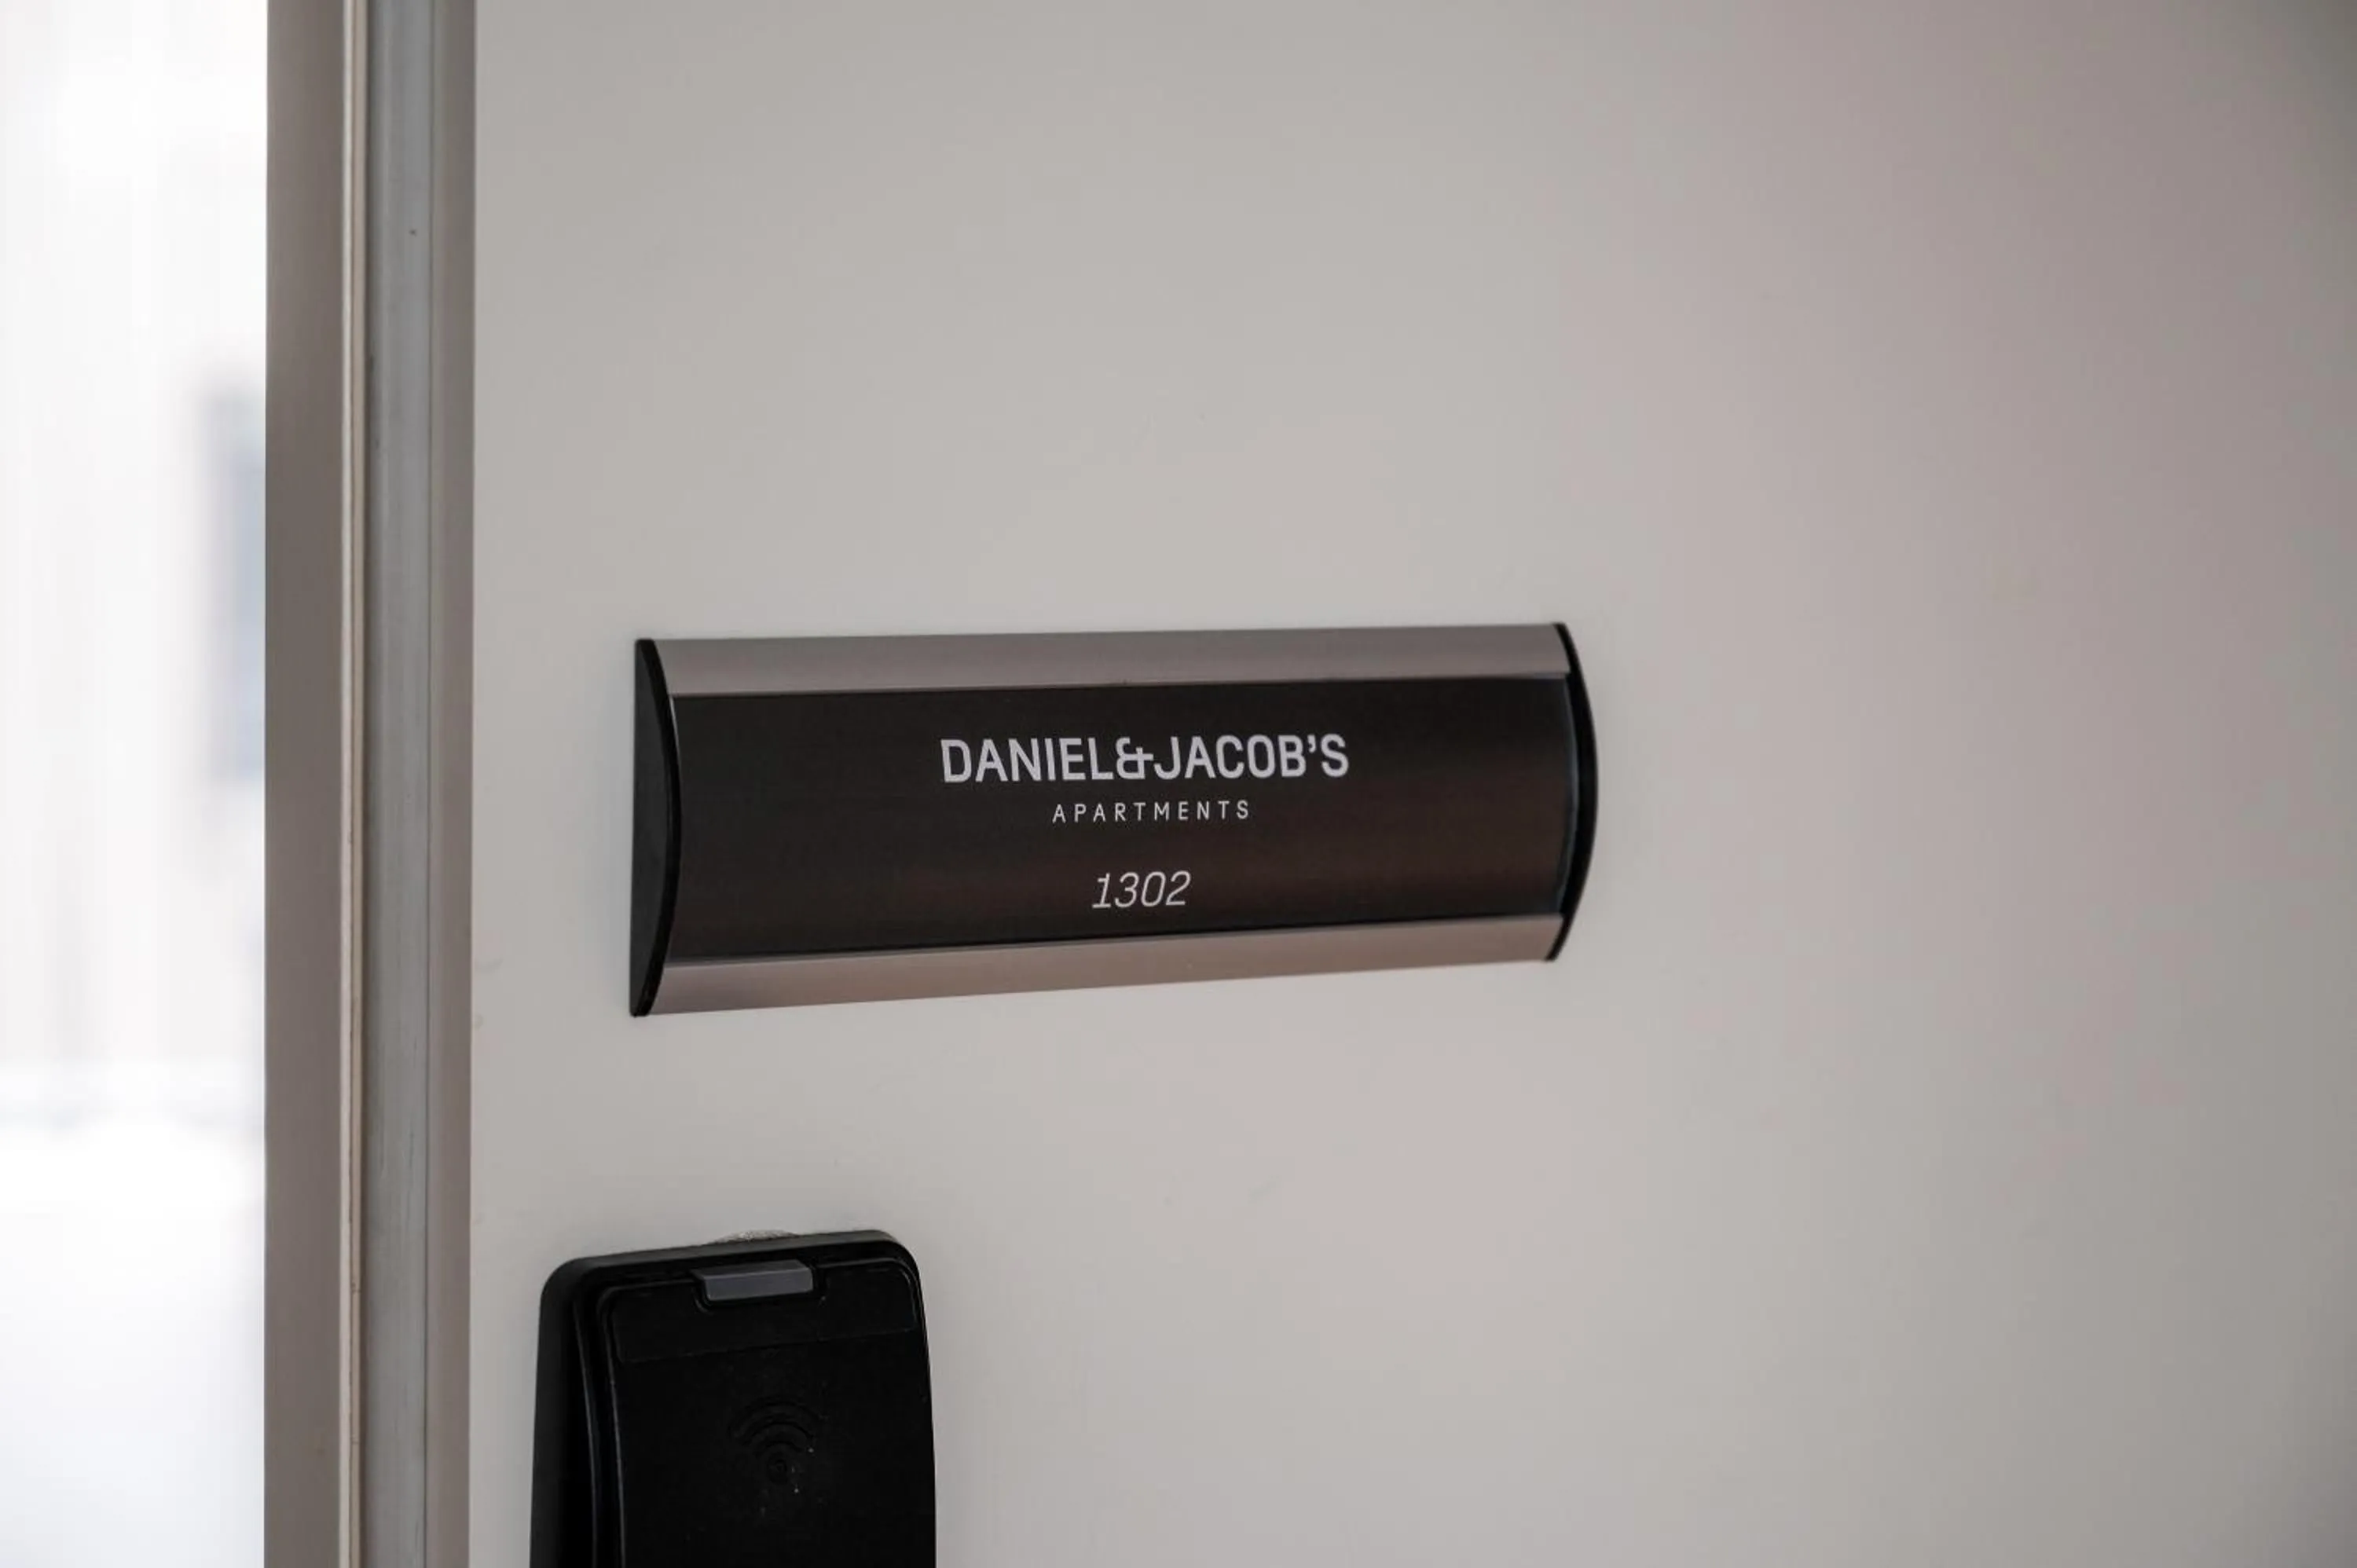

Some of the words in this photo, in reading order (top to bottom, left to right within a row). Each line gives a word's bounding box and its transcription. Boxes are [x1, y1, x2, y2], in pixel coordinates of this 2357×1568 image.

[940, 734, 1350, 784] DANIEL&JACOB’S
[1051, 799, 1250, 824] APARTMENTS
[1091, 870, 1192, 910] 1302
